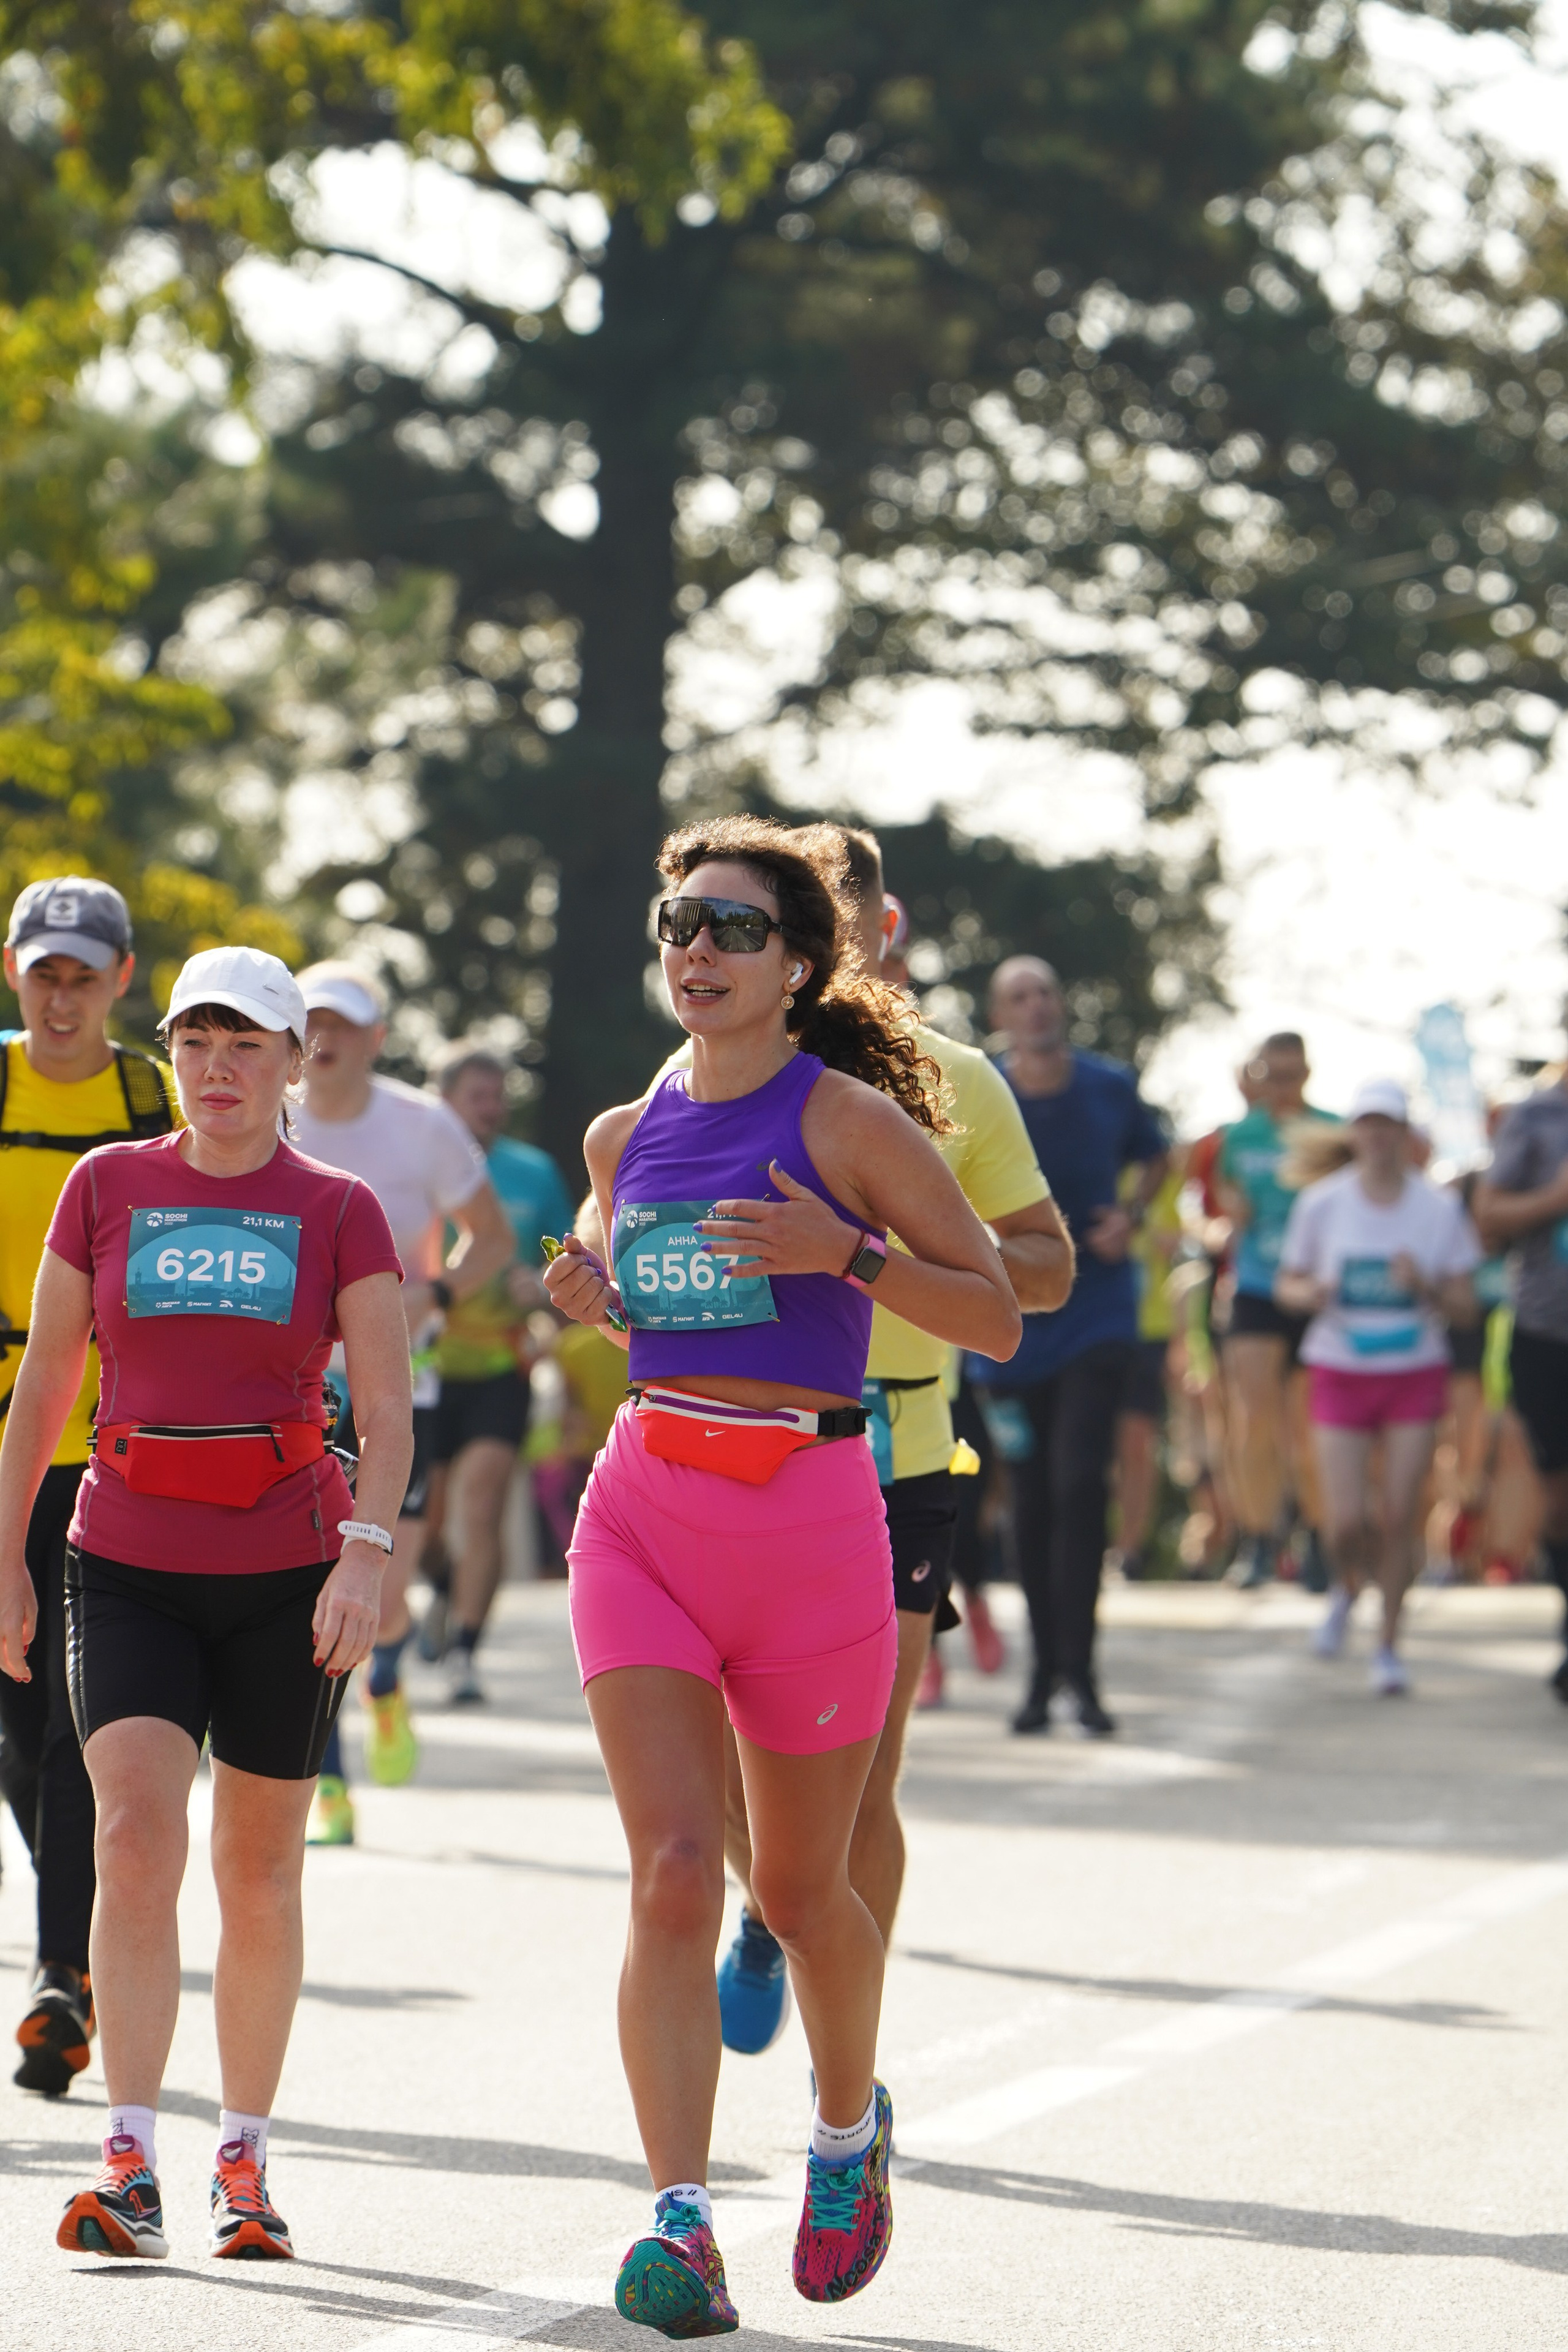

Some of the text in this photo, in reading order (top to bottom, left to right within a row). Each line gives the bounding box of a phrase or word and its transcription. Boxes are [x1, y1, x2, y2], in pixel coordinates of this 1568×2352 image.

[243, 1216, 285, 1229] 21,1 KM
[667, 1235, 698, 1246] АННА
[157, 1248, 266, 1284] 6215
[636, 1251, 739, 1293] 5567
